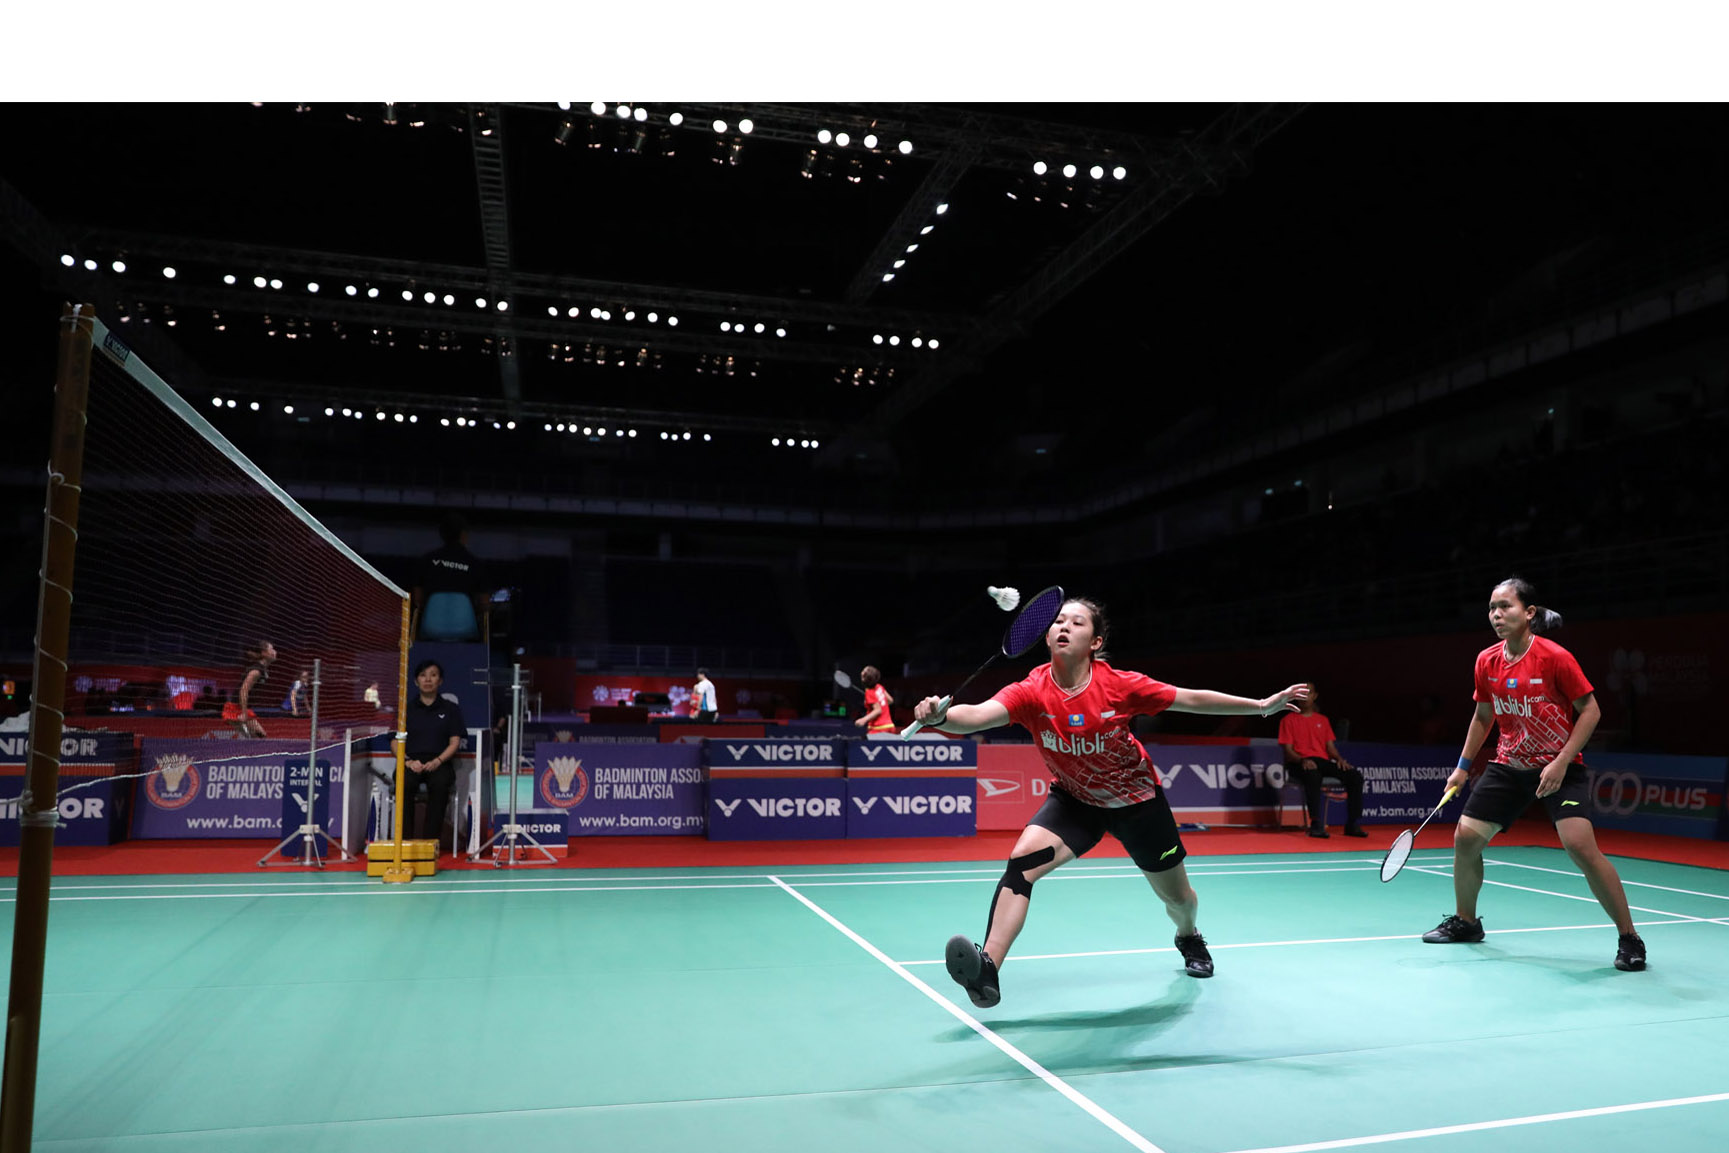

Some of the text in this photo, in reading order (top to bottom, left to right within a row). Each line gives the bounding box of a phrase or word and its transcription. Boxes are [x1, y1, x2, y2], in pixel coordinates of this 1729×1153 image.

[441, 560, 469, 571] VICTOR
[0, 737, 98, 756] VIOR
[753, 744, 833, 761] VICTOR
[886, 745, 963, 762] VICTOR
[290, 766, 323, 777] 2-MN
[595, 768, 663, 783] BADMINTON
[1189, 763, 1289, 789] VICTO
[206, 783, 221, 800] OF
[227, 783, 284, 800] MALAYS
[594, 784, 610, 799] OF
[613, 784, 675, 799] MALAYSIA
[1371, 780, 1416, 794] MALAYSIA
[882, 795, 973, 815] VICTOR
[1644, 784, 1708, 810] PLUS
[746, 797, 841, 818] VICTOR
[1361, 804, 1444, 818] ww.bam.org.my
